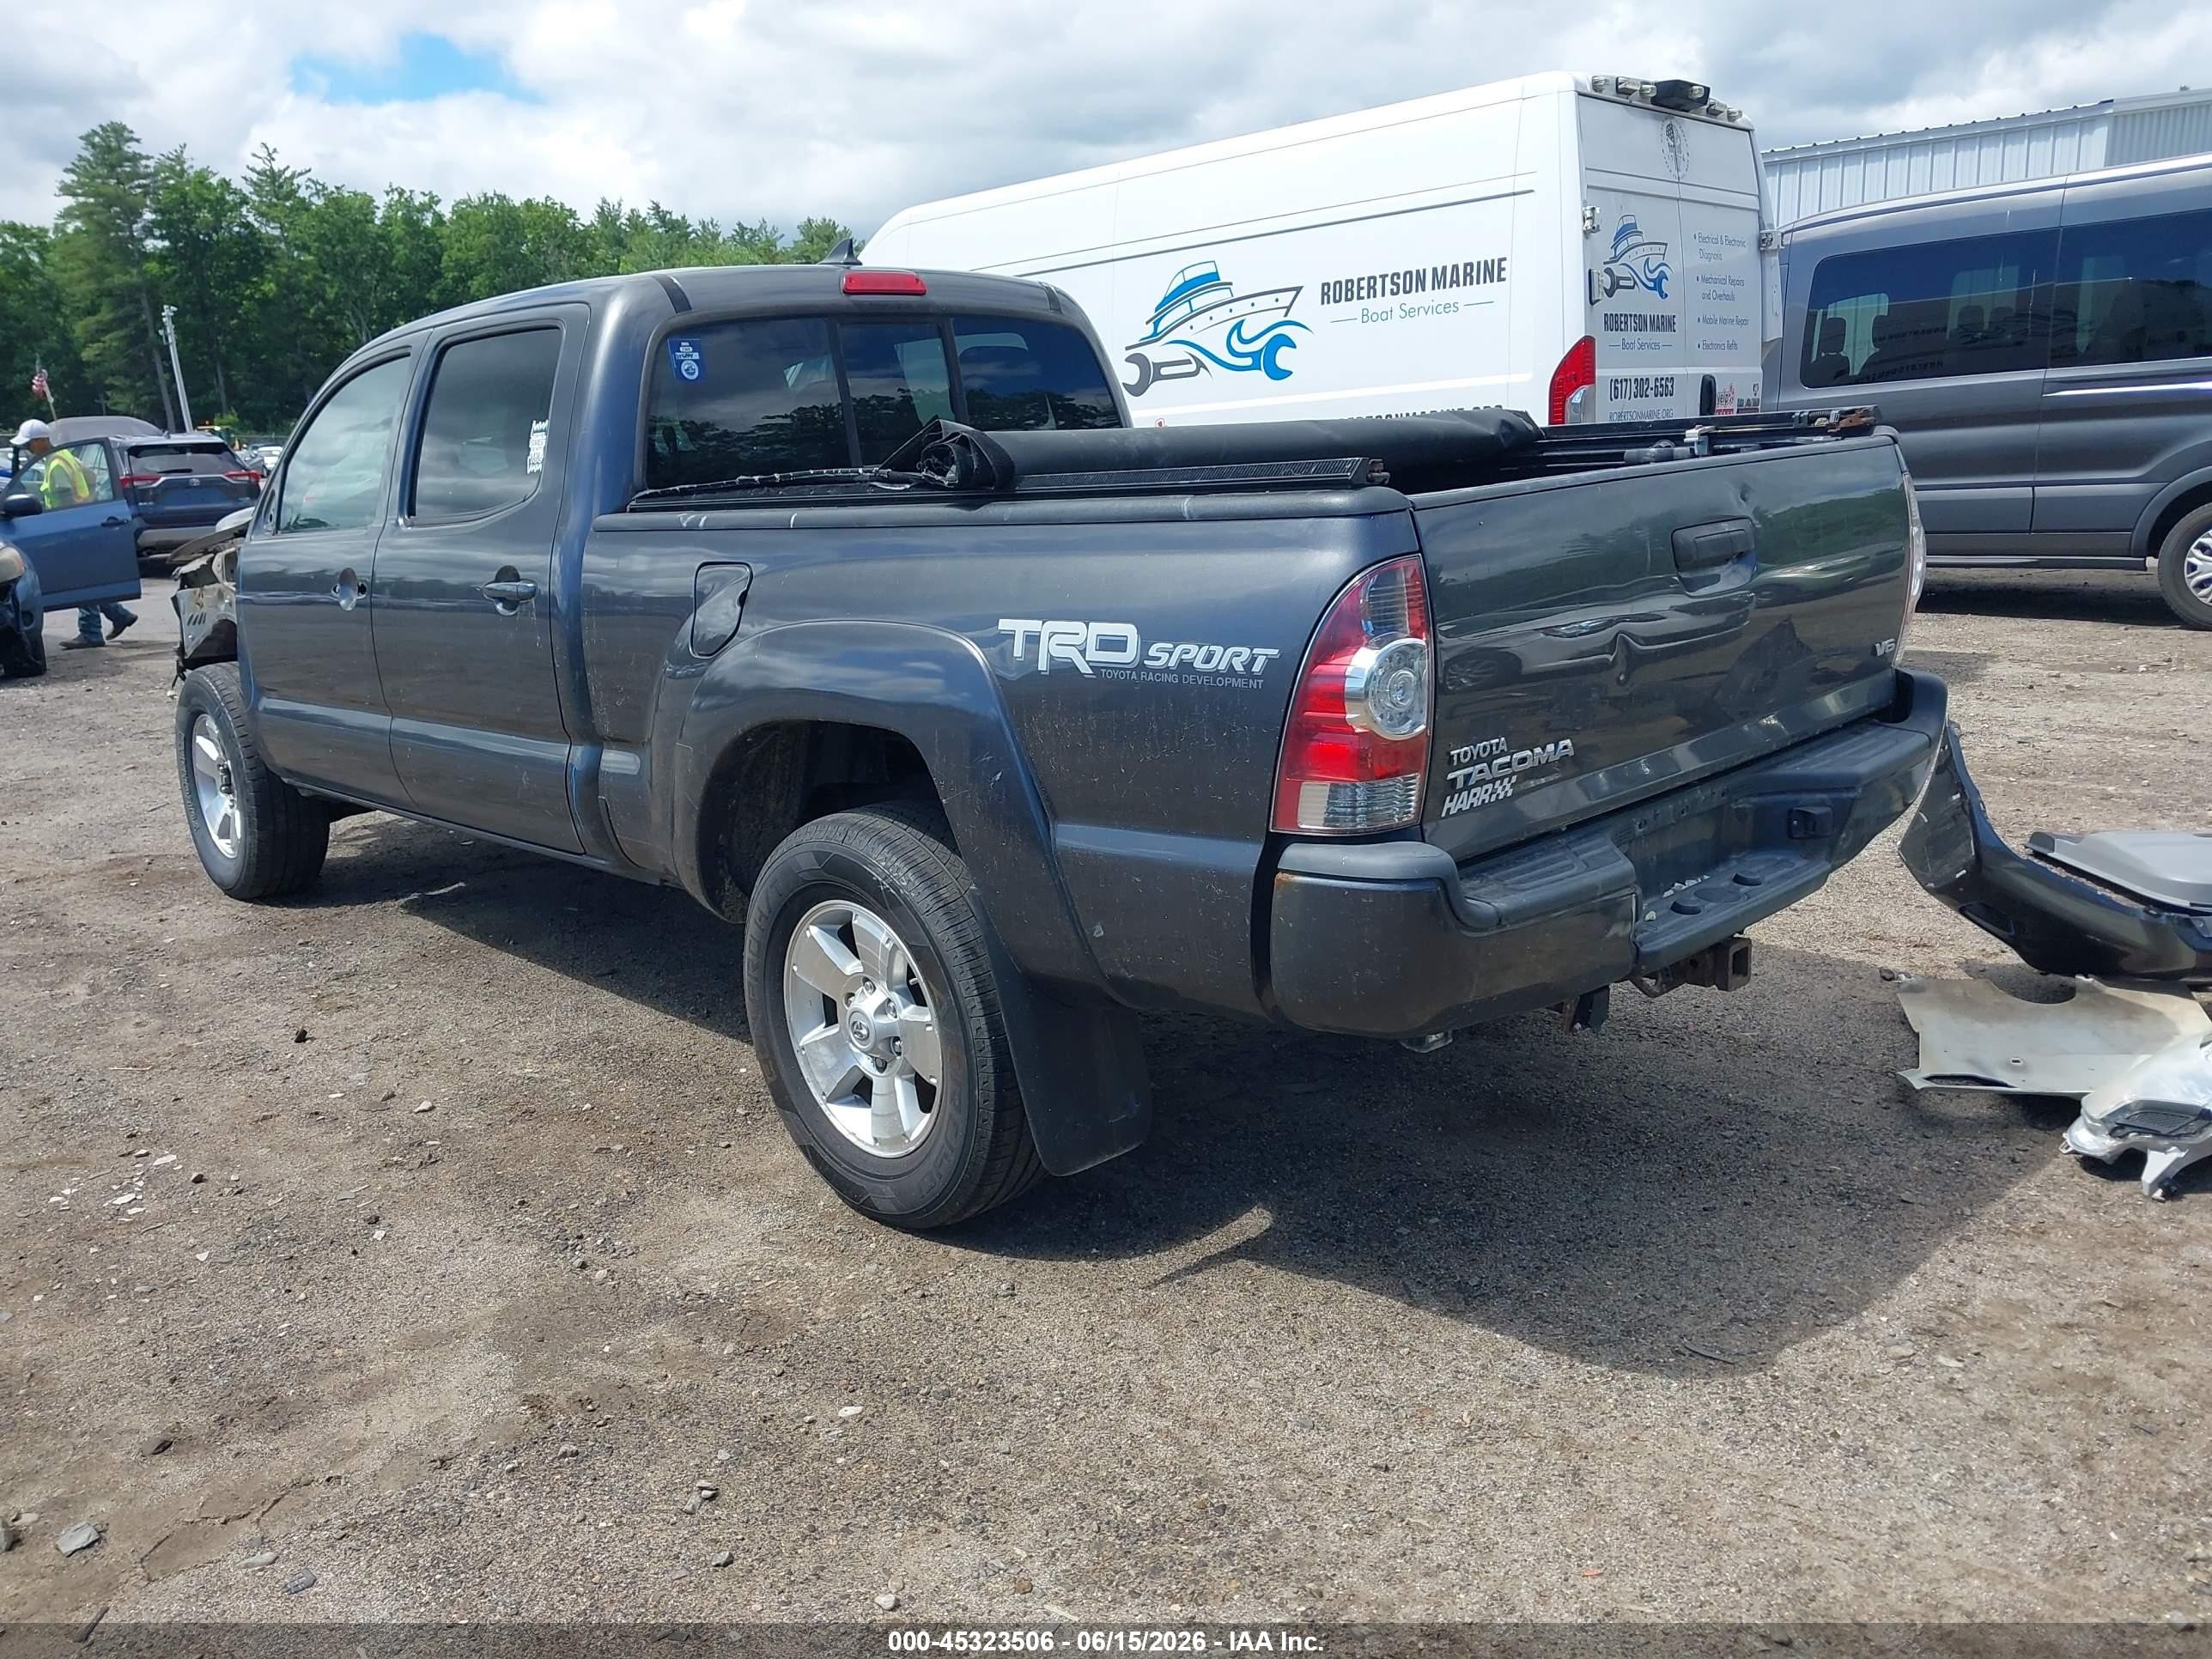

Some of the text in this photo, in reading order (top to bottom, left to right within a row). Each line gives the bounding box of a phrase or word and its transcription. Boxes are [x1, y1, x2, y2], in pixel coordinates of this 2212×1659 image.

[1698, 232, 1718, 245] Electrical
[1321, 257, 1507, 306] ROBERTSON MARINE
[1701, 289, 1711, 301] and
[1361, 300, 1459, 324] Boat Services
[1603, 313, 1676, 333] ROBERTSON MARINE
[1621, 337, 1661, 350] Boat Services
[1702, 339, 1726, 350] Electronics
[1609, 408, 1674, 422] ROBERTSONMARINE.ORG
[998, 618, 1281, 678] TRD SPORT
[1875, 638, 1895, 657] V6
[1100, 668, 1264, 690] TOYOTA RACING DEVELOPMENT
[1449, 738, 1508, 766] TOYOTA
[1446, 738, 1575, 790] TACOMA
